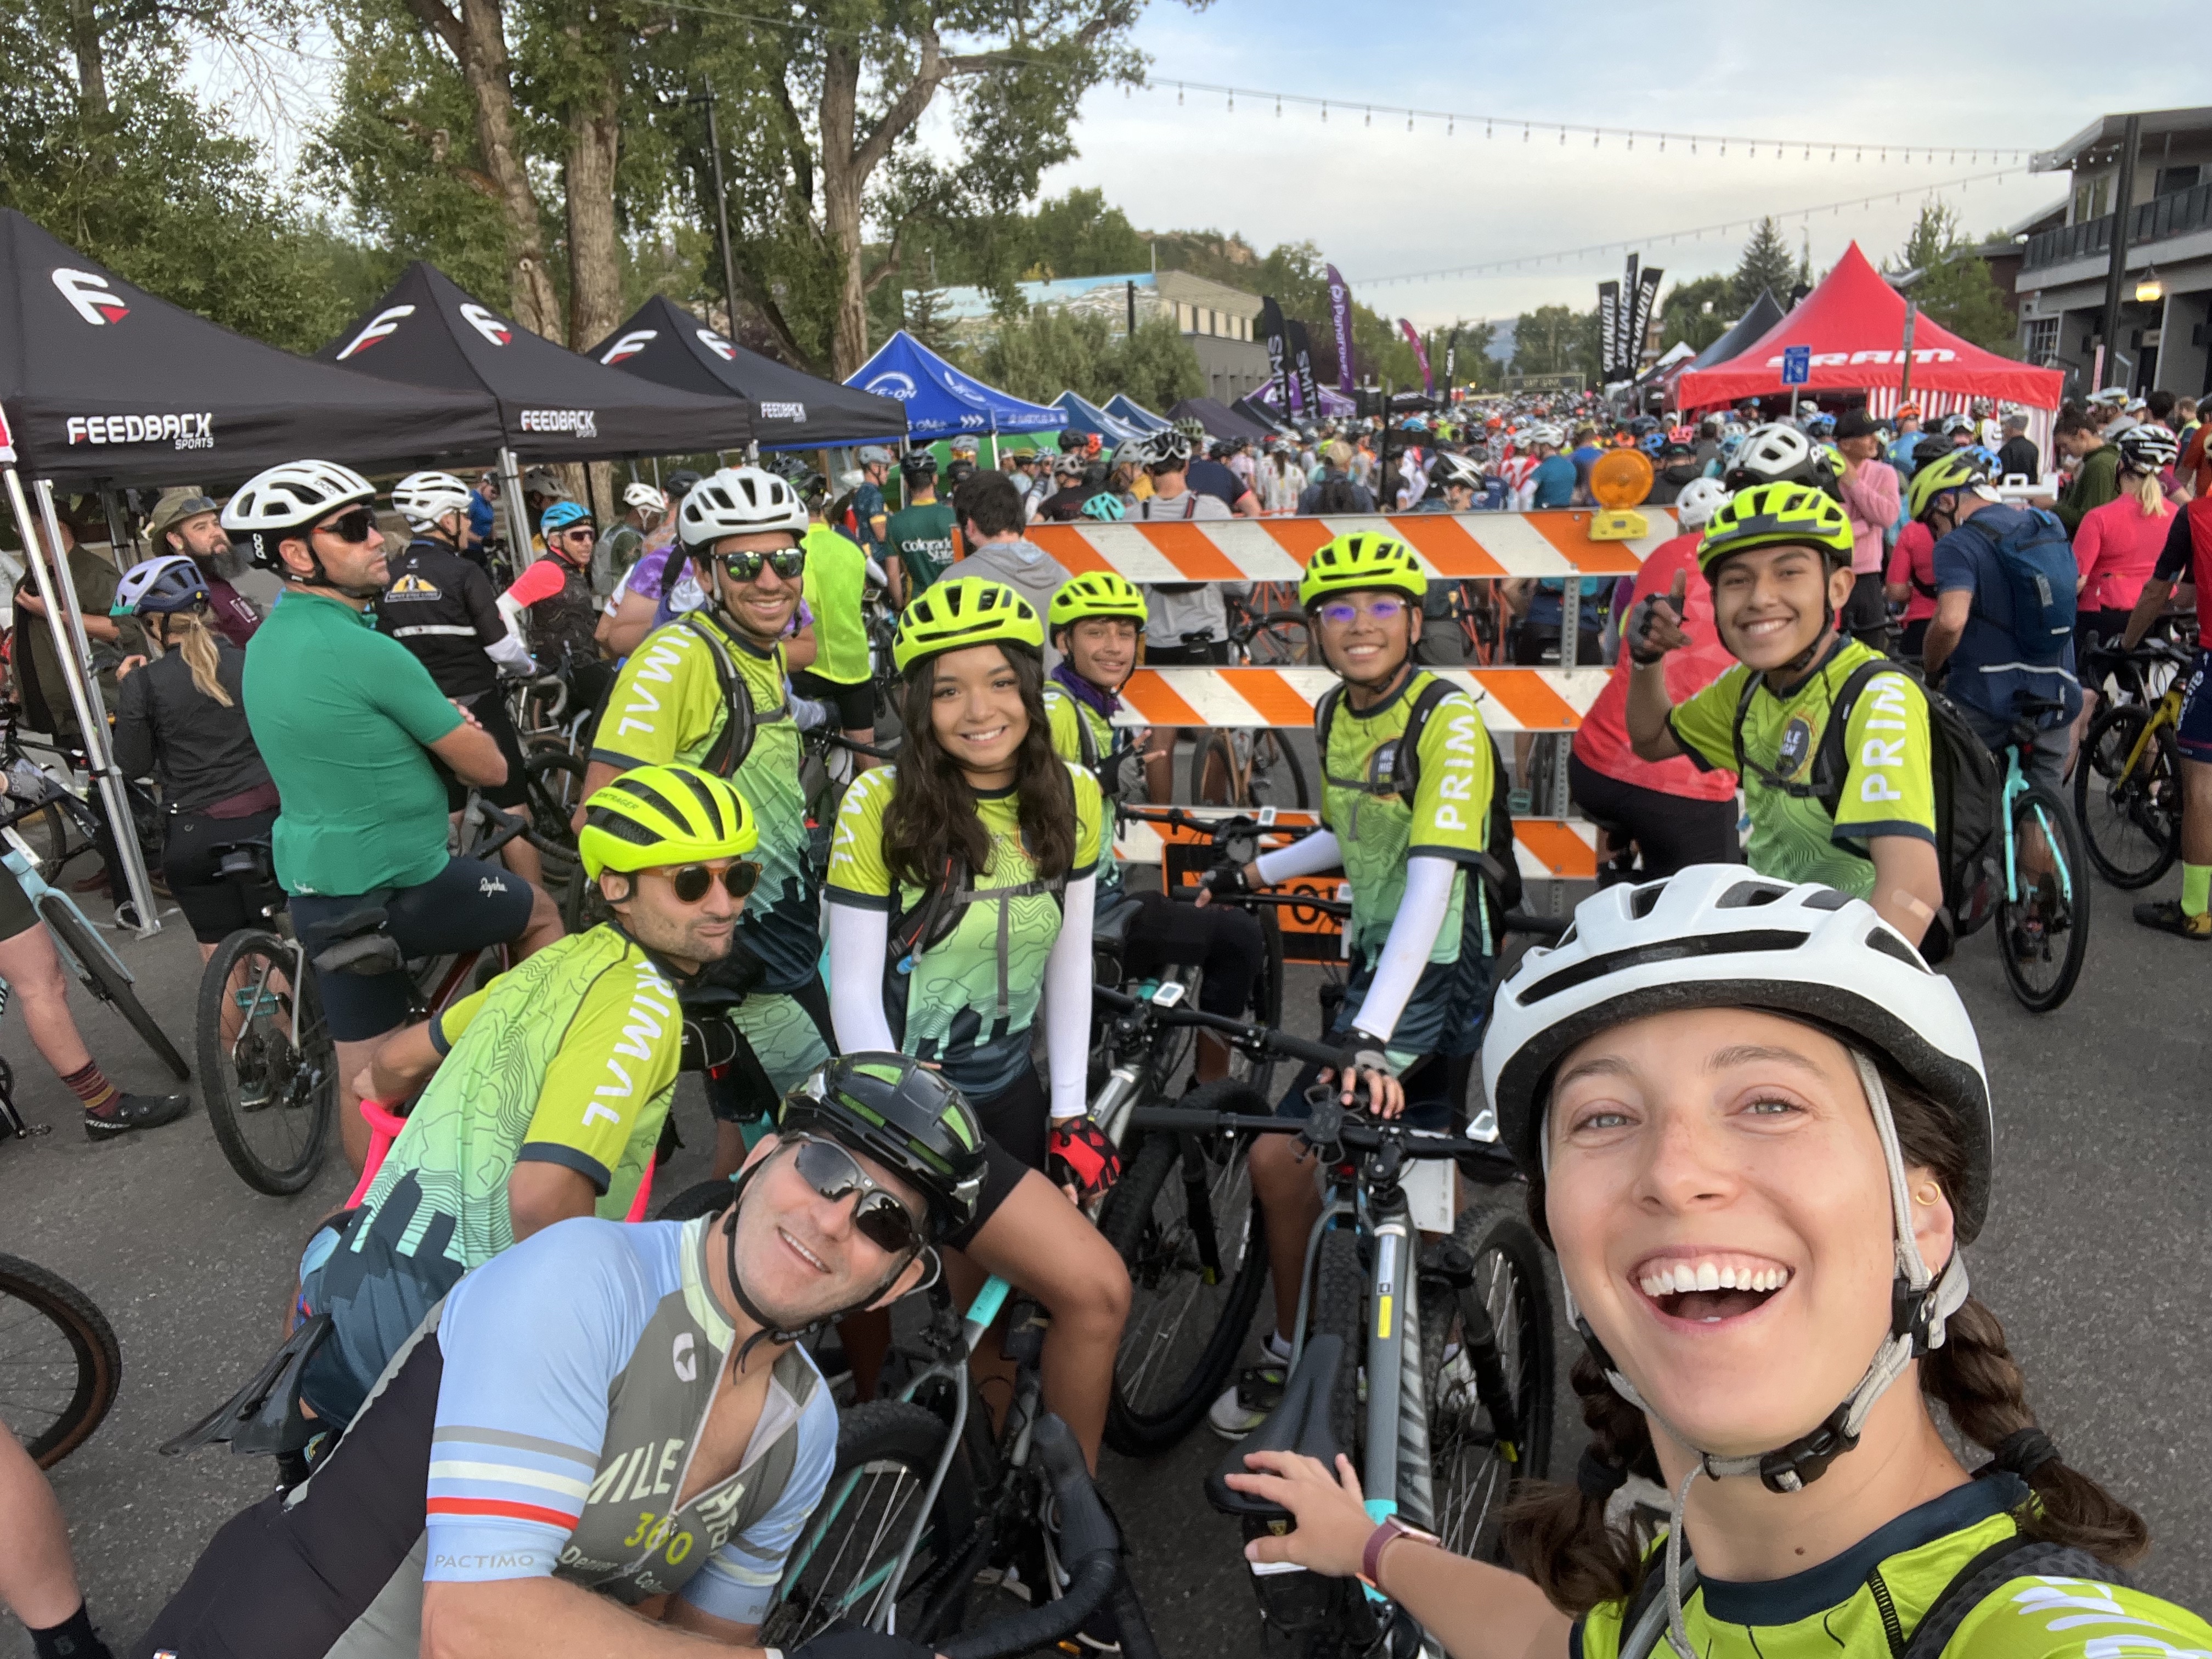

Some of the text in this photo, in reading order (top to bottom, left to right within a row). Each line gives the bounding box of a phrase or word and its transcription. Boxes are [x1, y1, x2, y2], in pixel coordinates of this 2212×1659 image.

[521, 409, 596, 432] FEEDBACK
[760, 401, 805, 418] FEEDBACK
[66, 412, 212, 445] FEEDBACK
[174, 437, 214, 450] SPORTS
[252, 532, 267, 560] POC
[1861, 672, 1907, 803] PRIM
[479, 876, 508, 898] Rapha
[434, 1554, 534, 1570] PACTIMO
